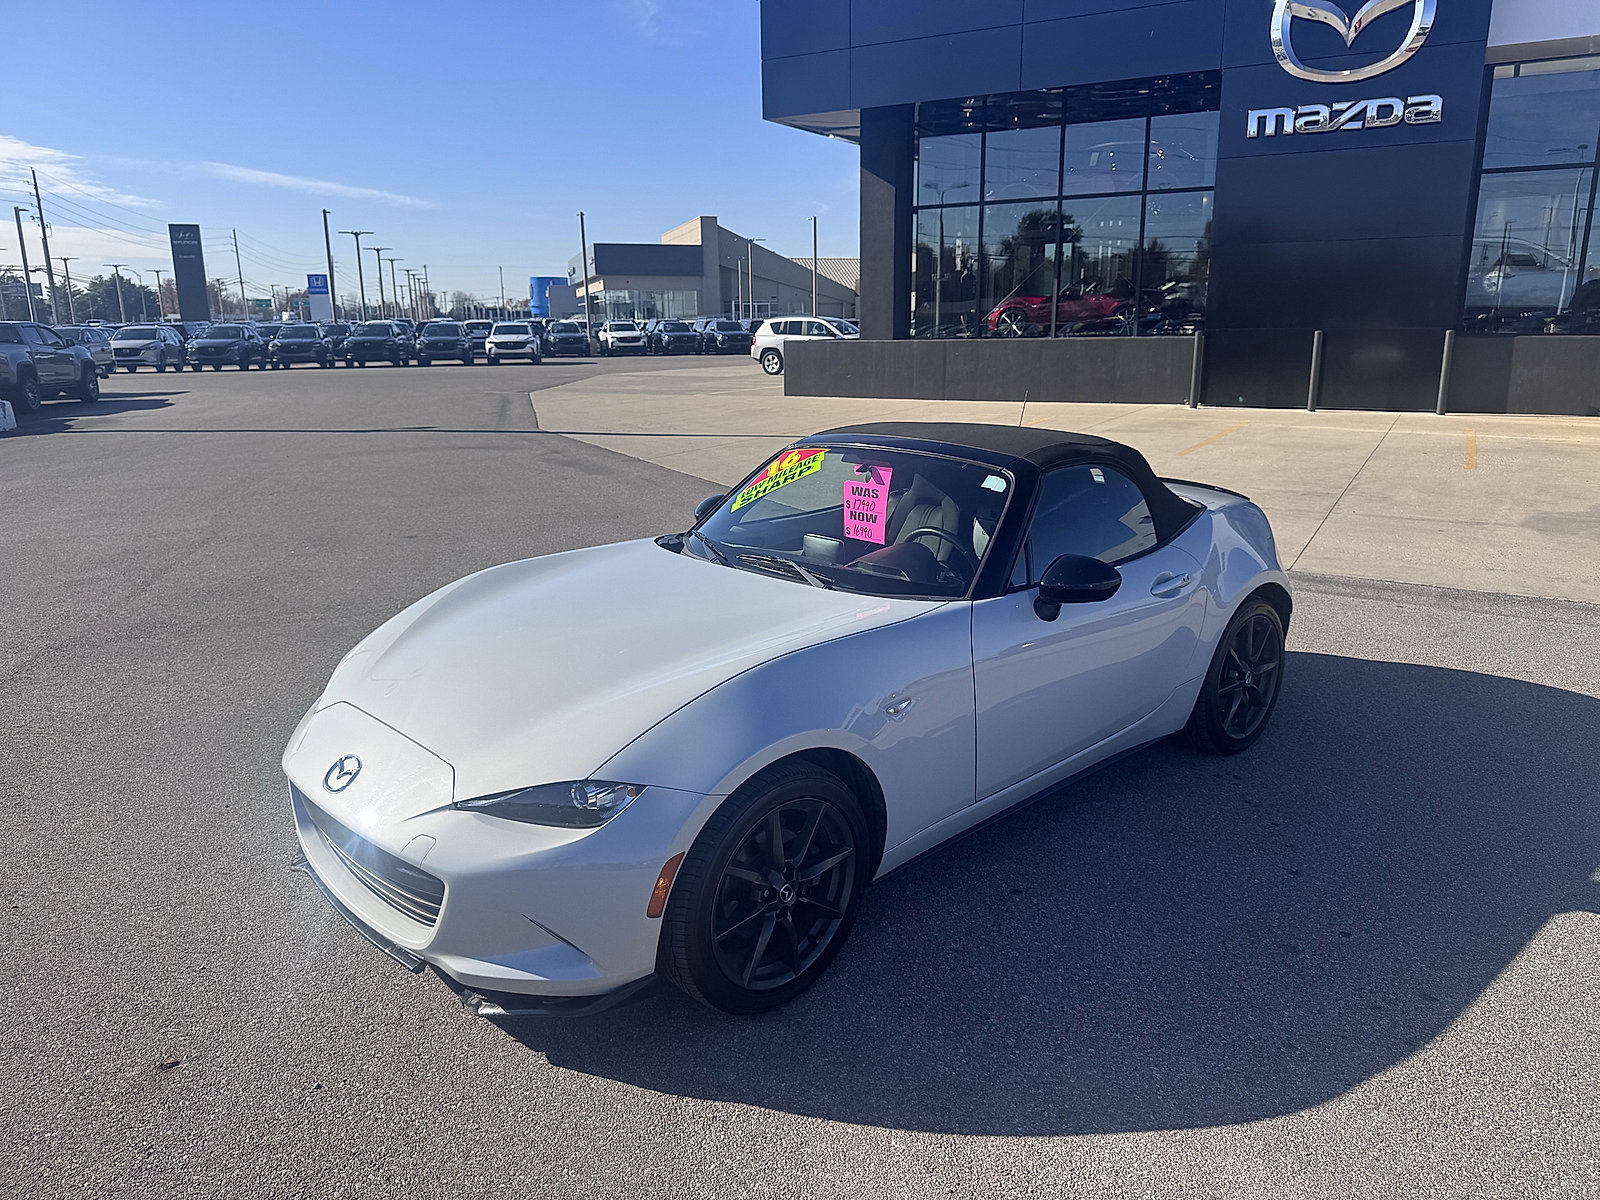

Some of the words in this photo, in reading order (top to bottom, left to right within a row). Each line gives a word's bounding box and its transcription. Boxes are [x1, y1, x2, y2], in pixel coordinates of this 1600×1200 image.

[1246, 93, 1445, 138] mazda
[741, 480, 765, 499] LOW
[766, 454, 821, 485] MILEAGE
[767, 450, 801, 477] 16
[740, 466, 812, 506] SHARP
[851, 486, 880, 498] WAS
[849, 511, 878, 523] NOW
